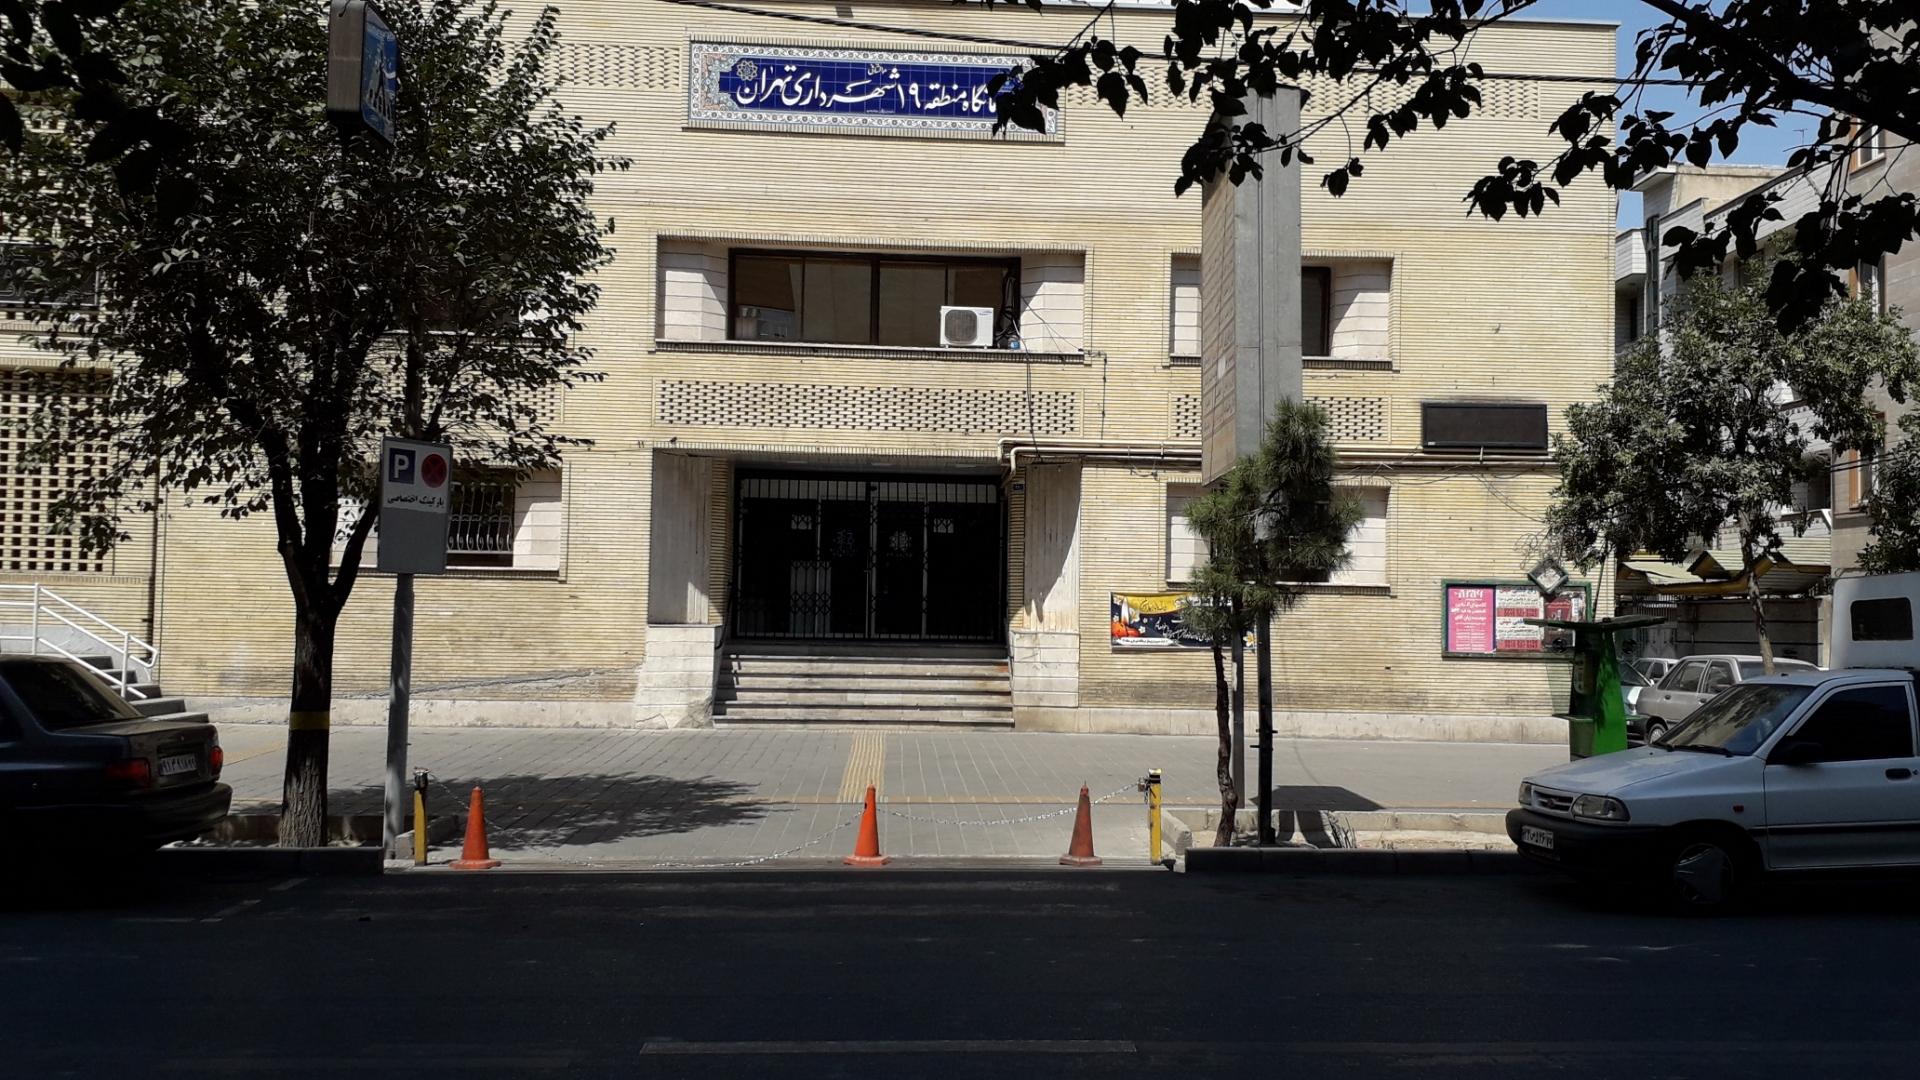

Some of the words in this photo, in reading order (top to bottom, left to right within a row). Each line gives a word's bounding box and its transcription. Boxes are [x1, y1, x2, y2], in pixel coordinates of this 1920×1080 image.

[736, 65, 797, 105] تهران
[782, 67, 900, 108] شهرداری
[898, 83, 921, 109] ۱۹
[924, 83, 967, 110] منطقه
[393, 454, 409, 479] P
[387, 494, 418, 504] اختصاصی
[419, 495, 445, 508] پارکینگ
